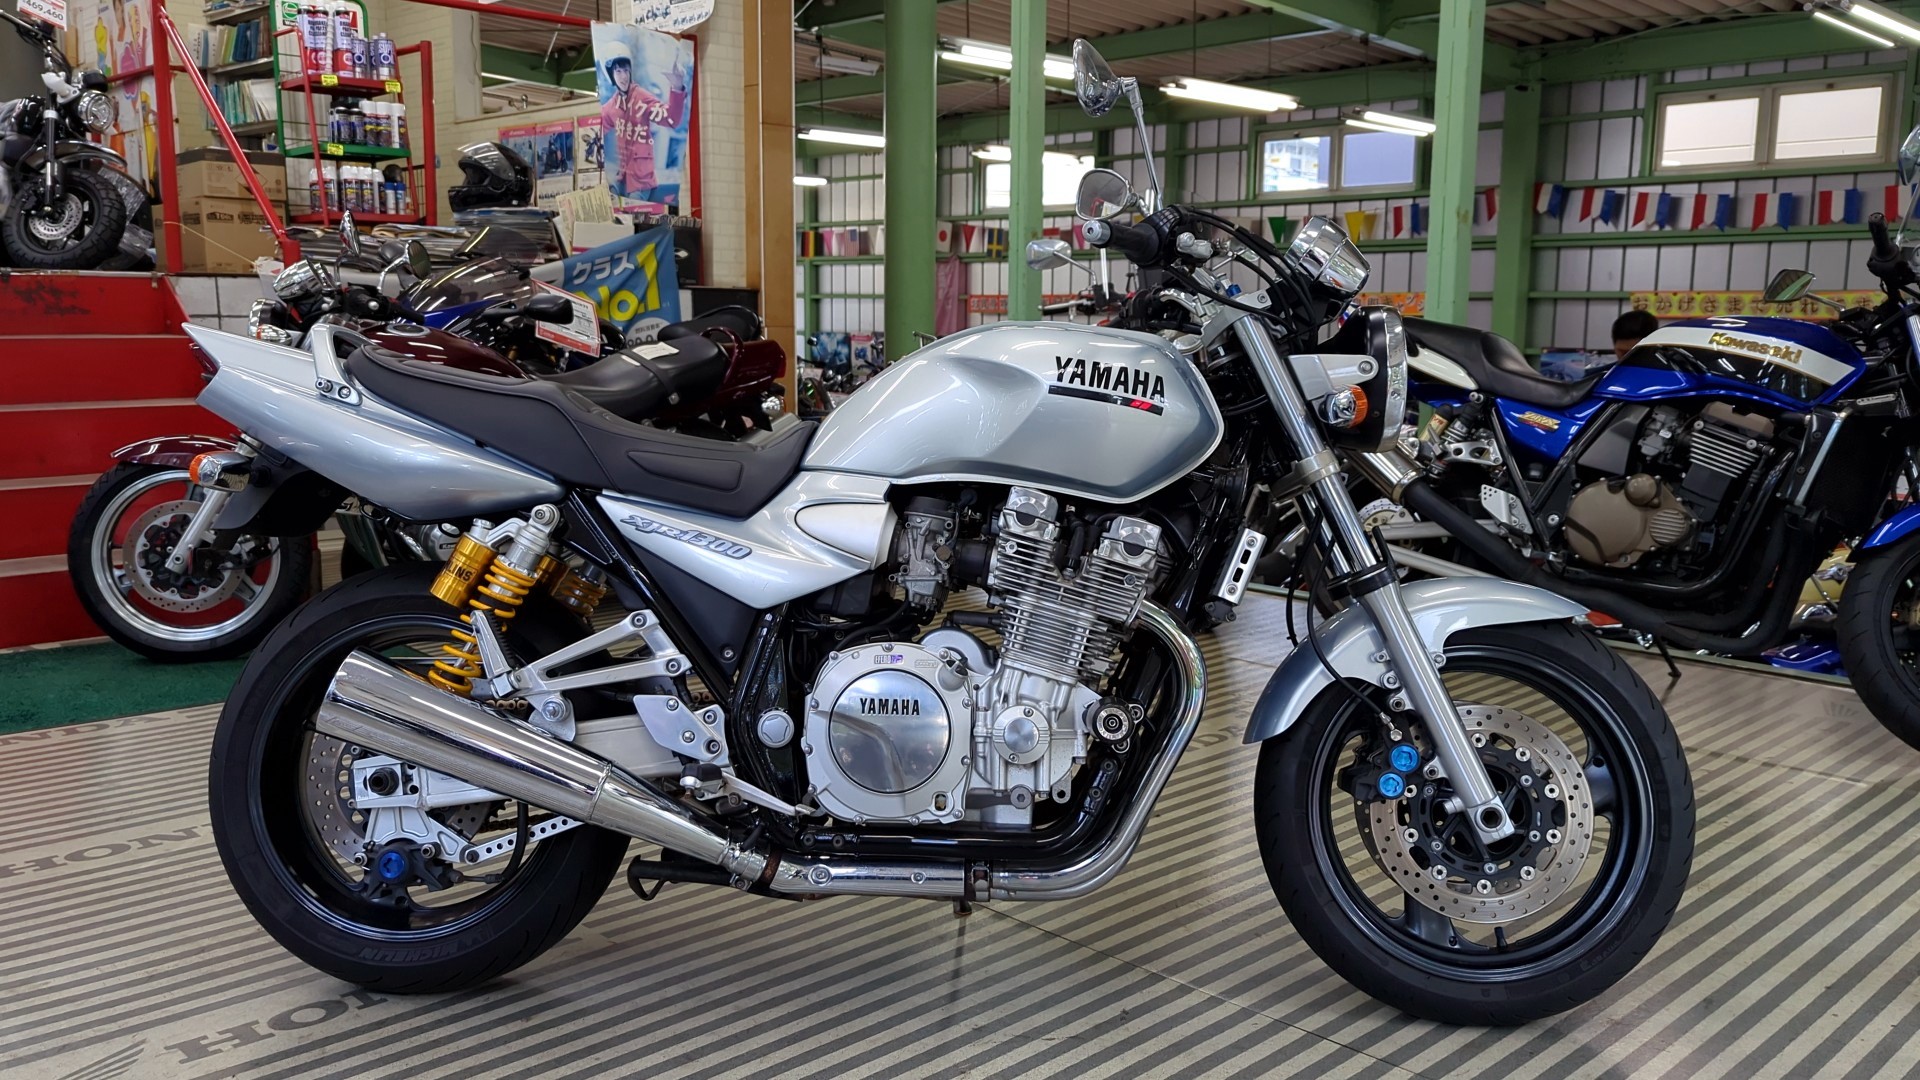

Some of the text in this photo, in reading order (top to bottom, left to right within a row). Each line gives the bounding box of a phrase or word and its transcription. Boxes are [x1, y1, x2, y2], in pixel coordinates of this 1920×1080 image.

[615, 95, 674, 125] バイクが、
[615, 118, 655, 145] 好きだ。
[573, 250, 635, 285] クラス
[576, 242, 661, 322] No.1
[1708, 332, 1803, 365] Kawasaki
[1055, 356, 1165, 404] YAMAHA
[620, 514, 753, 560] XJR1300
[859, 697, 920, 716] YAMAHA
[0, 823, 212, 879] HON
[358, 942, 457, 962] MICHELIN
